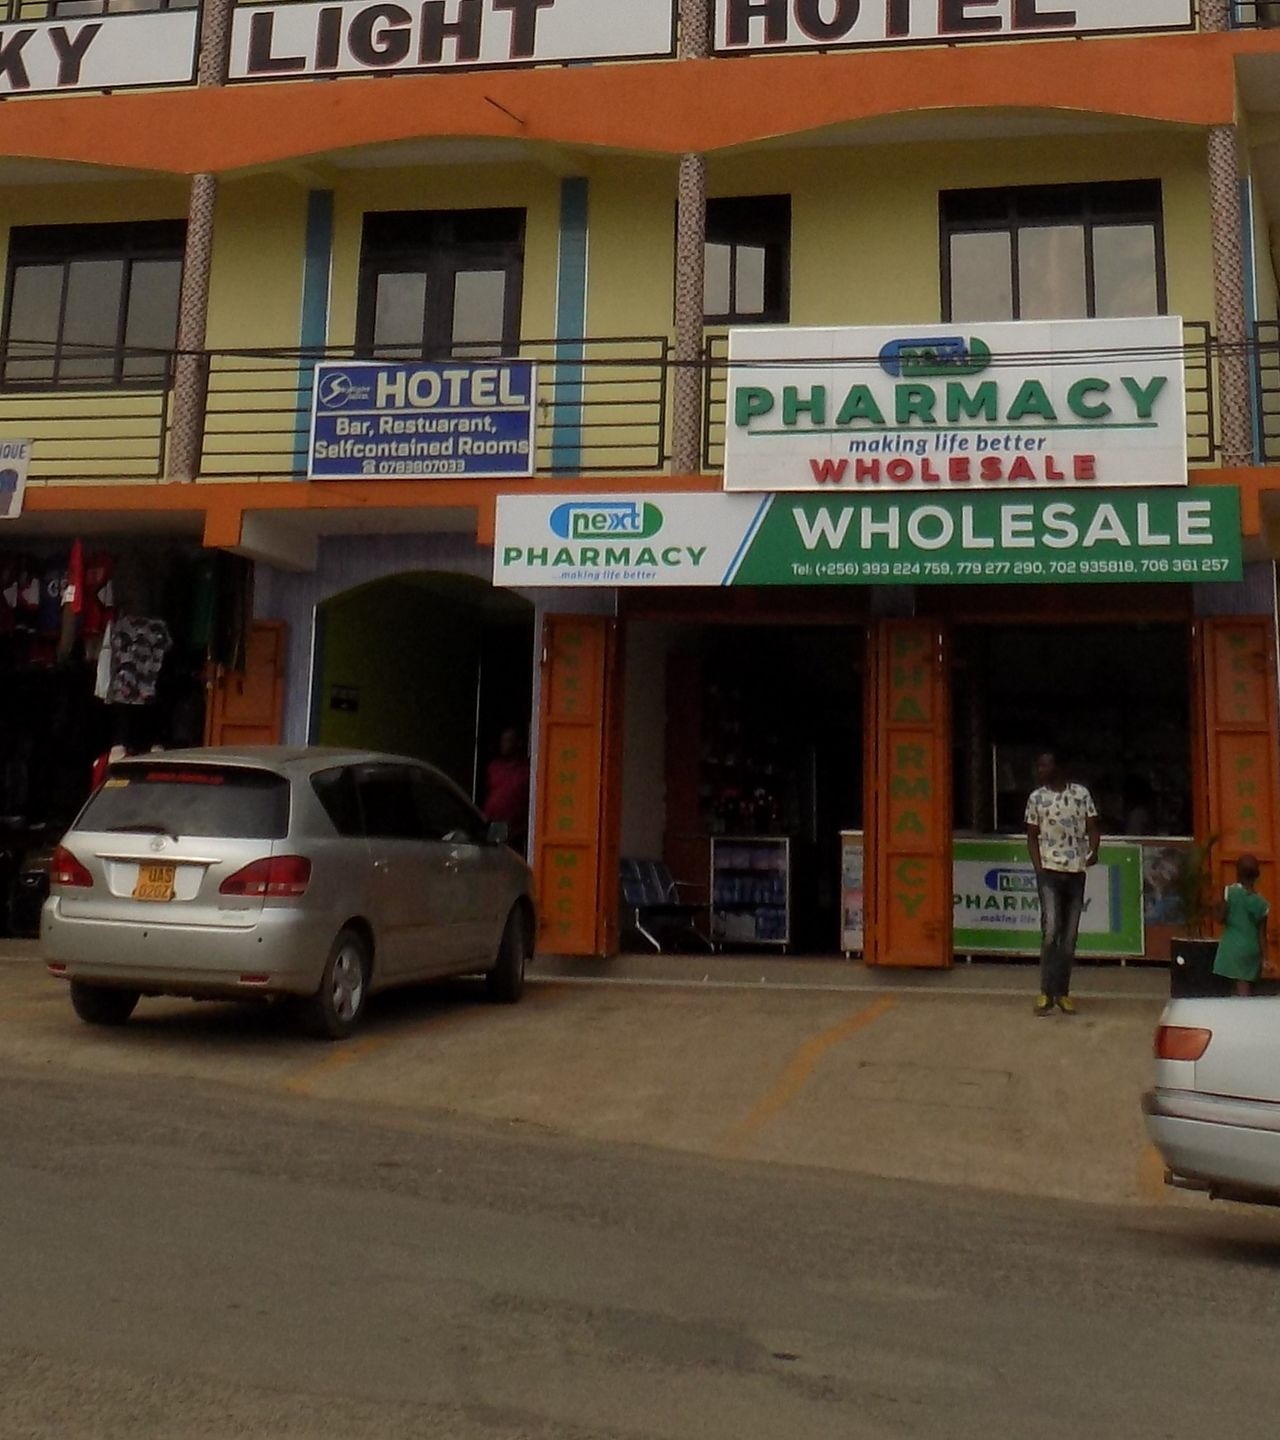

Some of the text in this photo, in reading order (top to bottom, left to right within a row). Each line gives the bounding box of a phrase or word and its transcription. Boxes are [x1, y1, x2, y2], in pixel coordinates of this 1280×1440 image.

[375, 368, 526, 409] HOTEL
[734, 376, 1168, 427] PHARMACY
[336, 415, 497, 437] Bar, Restuarant,
[315, 436, 529, 459] Selfcontained Rooms
[848, 433, 1047, 456] making life better
[809, 454, 1097, 484] WHOLESALE
[572, 510, 641, 531] next
[792, 501, 1214, 550] WHOLESALE
[503, 546, 708, 567] PHARMACY
[792, 563, 813, 575] Tel:
[815, 563, 859, 576] (+256)
[862, 563, 890, 575] 393
[893, 563, 920, 575] 224
[956, 562, 982, 574] 779
[985, 562, 1011, 574] 277
[1049, 561, 1077, 573] 702
[1142, 560, 1170, 572] 706
[1173, 560, 1199, 571] 361
[1201, 559, 1230, 571] 257
[603, 570, 621, 579] life
[623, 570, 657, 580] better
[894, 632, 932, 918] PHARMACY
